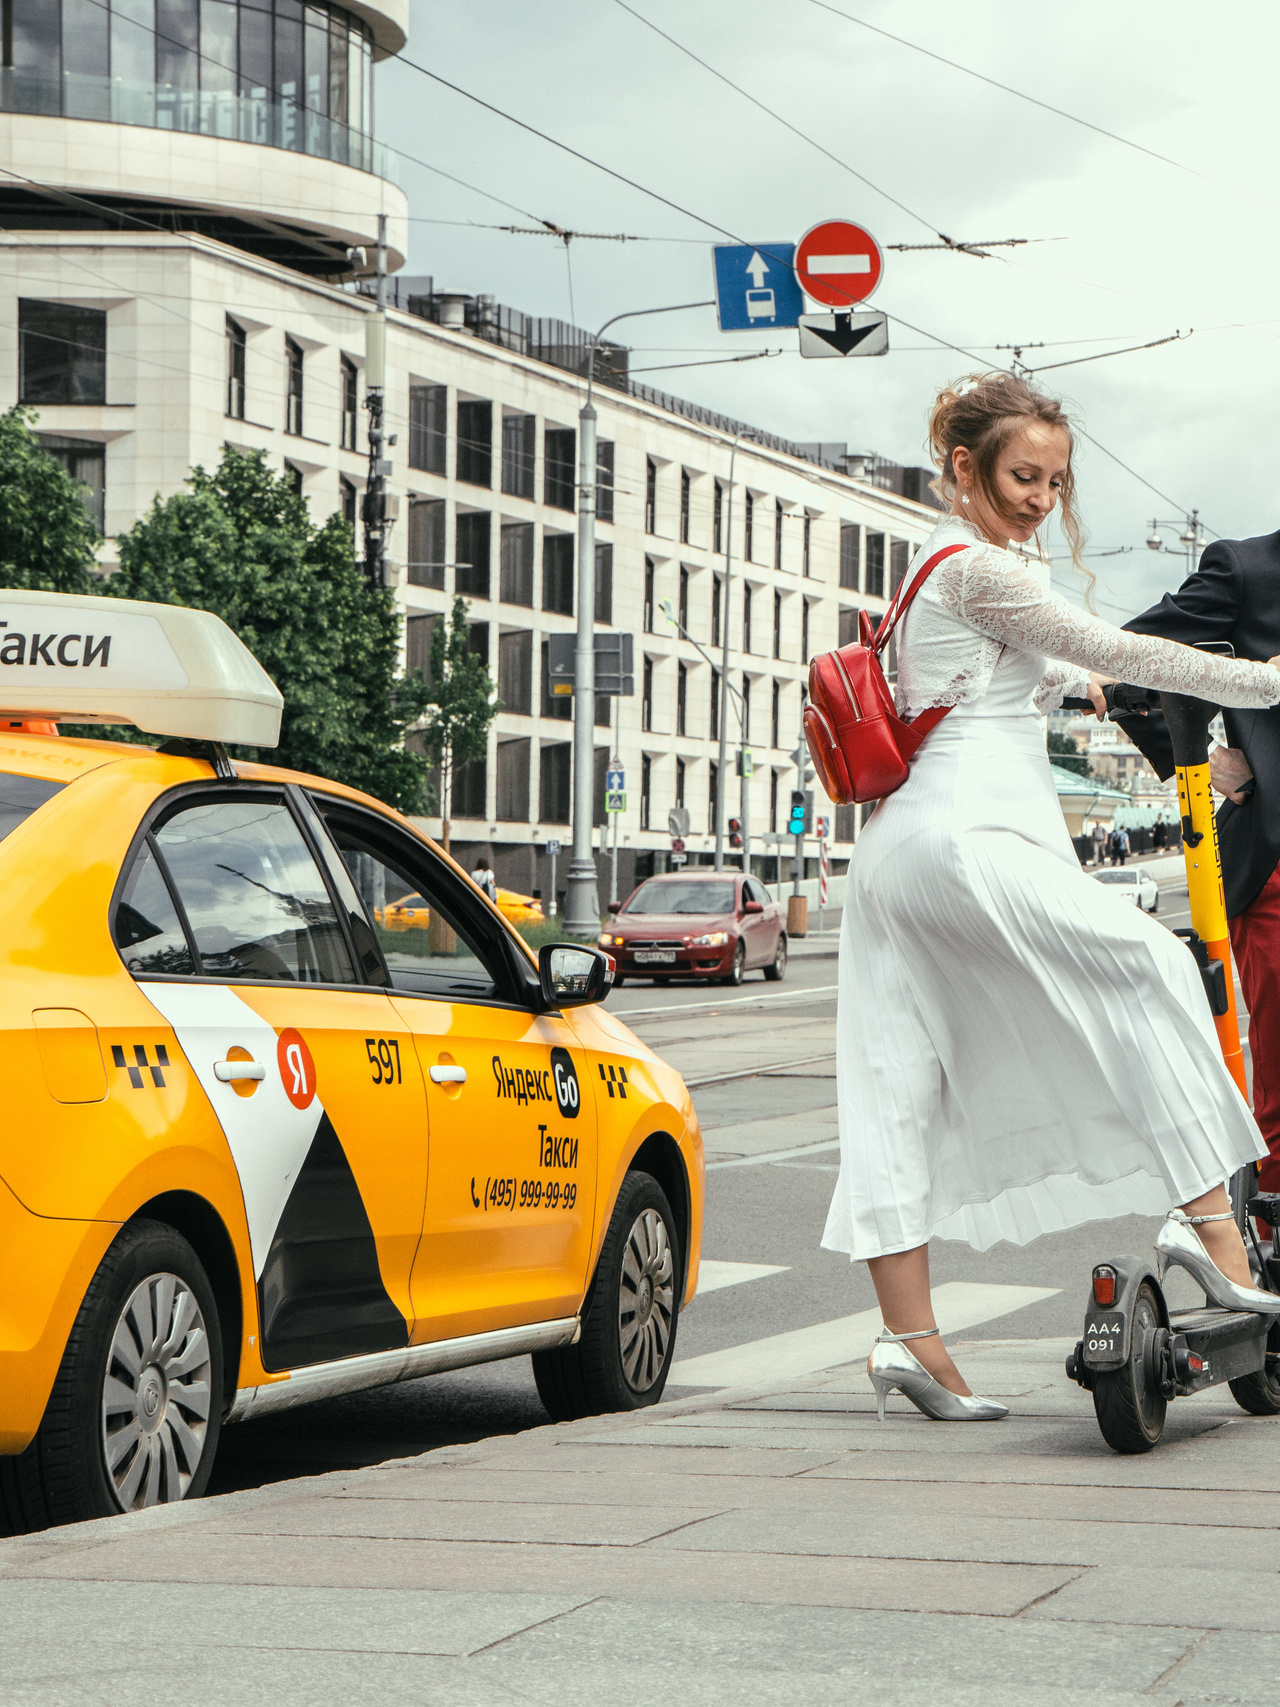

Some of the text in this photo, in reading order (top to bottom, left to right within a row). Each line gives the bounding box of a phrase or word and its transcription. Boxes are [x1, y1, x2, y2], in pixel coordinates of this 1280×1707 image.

[0, 621, 112, 668] акси
[286, 1043, 308, 1095] Я
[365, 1038, 402, 1085] 597
[492, 1055, 579, 1109] Яндекс Go
[538, 1124, 579, 1169] Такси
[484, 1176, 578, 1212] (495) 999-99-99
[1087, 1322, 1121, 1335] AA4
[1088, 1339, 1114, 1351] 091
